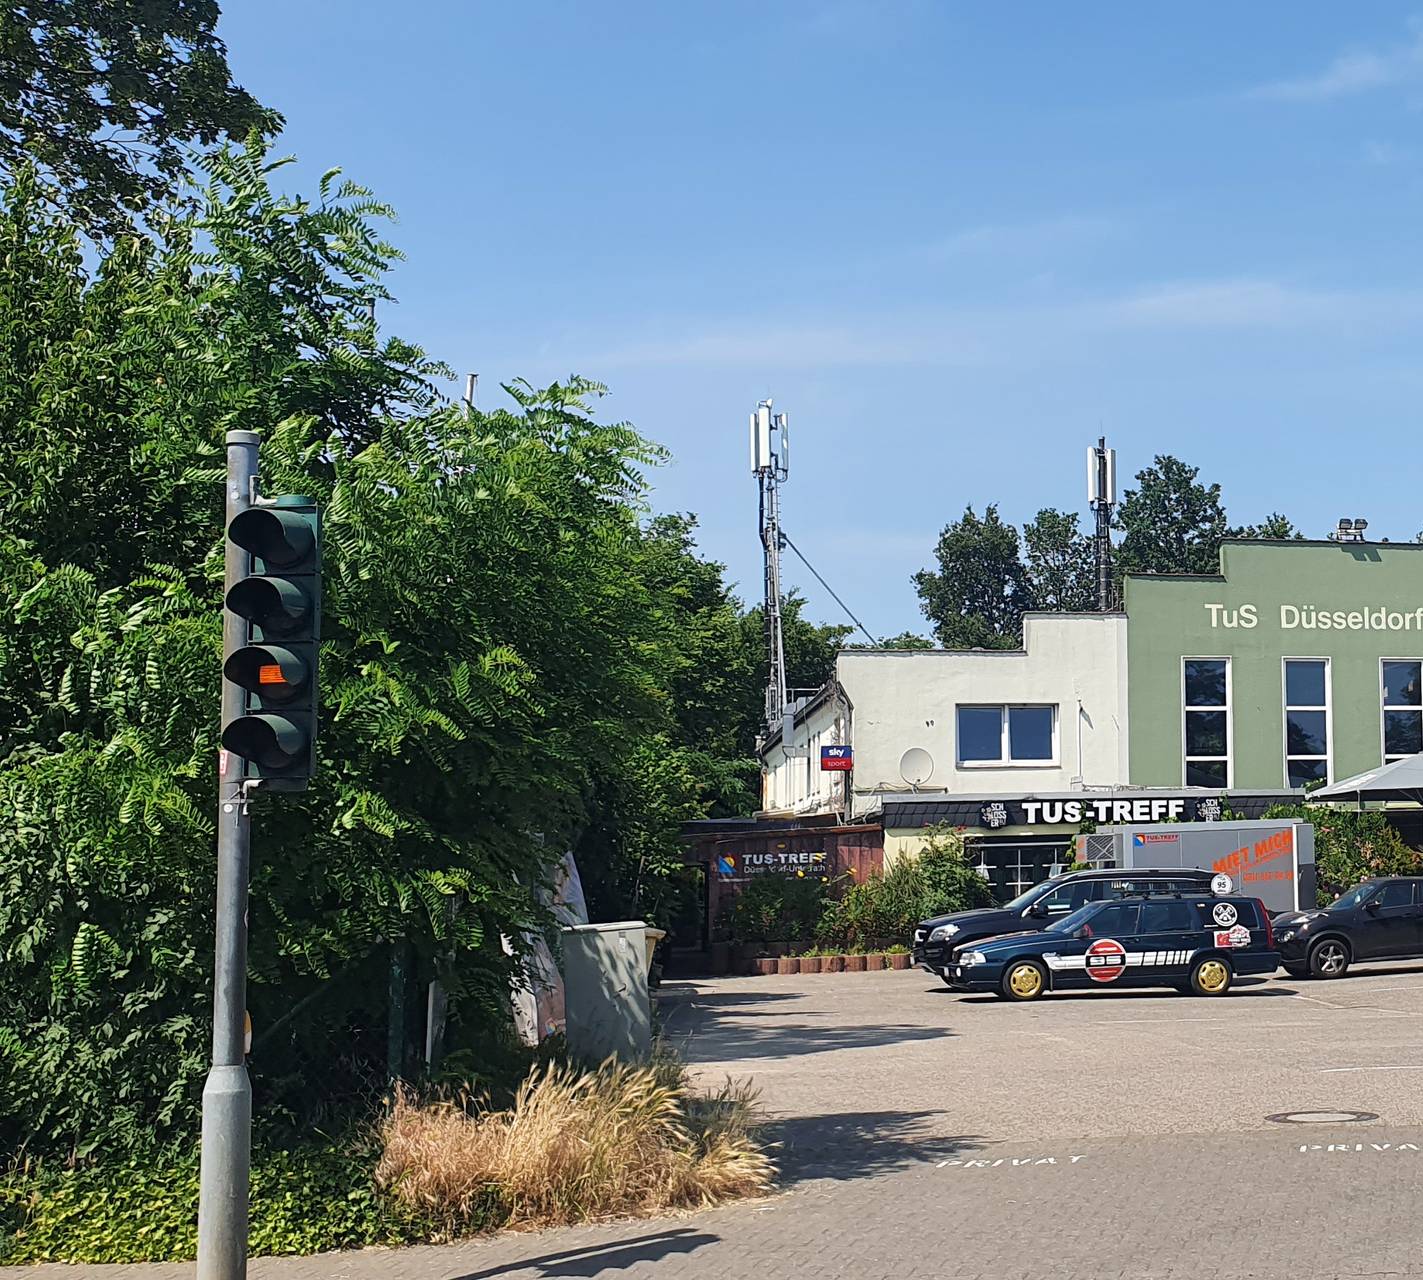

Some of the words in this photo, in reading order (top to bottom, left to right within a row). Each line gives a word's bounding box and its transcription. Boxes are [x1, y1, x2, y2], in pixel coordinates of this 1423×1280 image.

[1204, 603, 1258, 628] TuS
[1280, 604, 1423, 631] Düsseldorf
[828, 748, 845, 757] sky
[1022, 799, 1184, 824] TUS-TREFF
[742, 852, 827, 865] TUS-TREFF
[1212, 846, 1249, 874] MIET
[1217, 881, 1227, 889] 95
[936, 1155, 1088, 1168] PRIVAT
